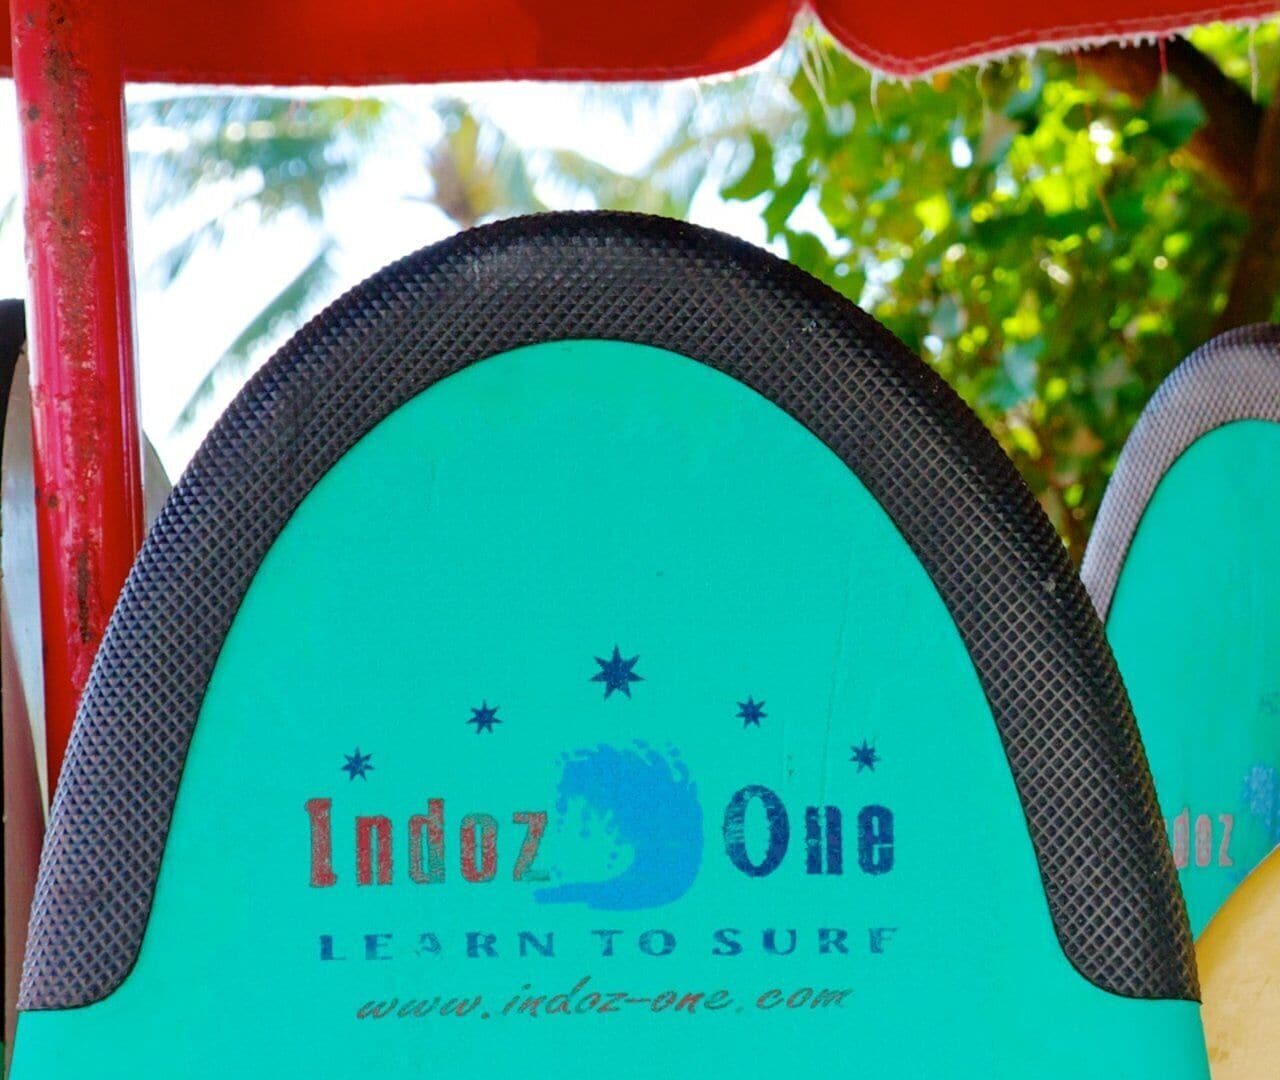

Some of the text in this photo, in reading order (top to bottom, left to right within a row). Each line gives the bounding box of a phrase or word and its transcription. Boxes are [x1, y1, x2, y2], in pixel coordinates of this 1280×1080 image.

[304, 784, 896, 889] Indoz One
[1168, 806, 1234, 870] doz
[591, 927, 677, 957] TO
[711, 926, 898, 957] SURF
